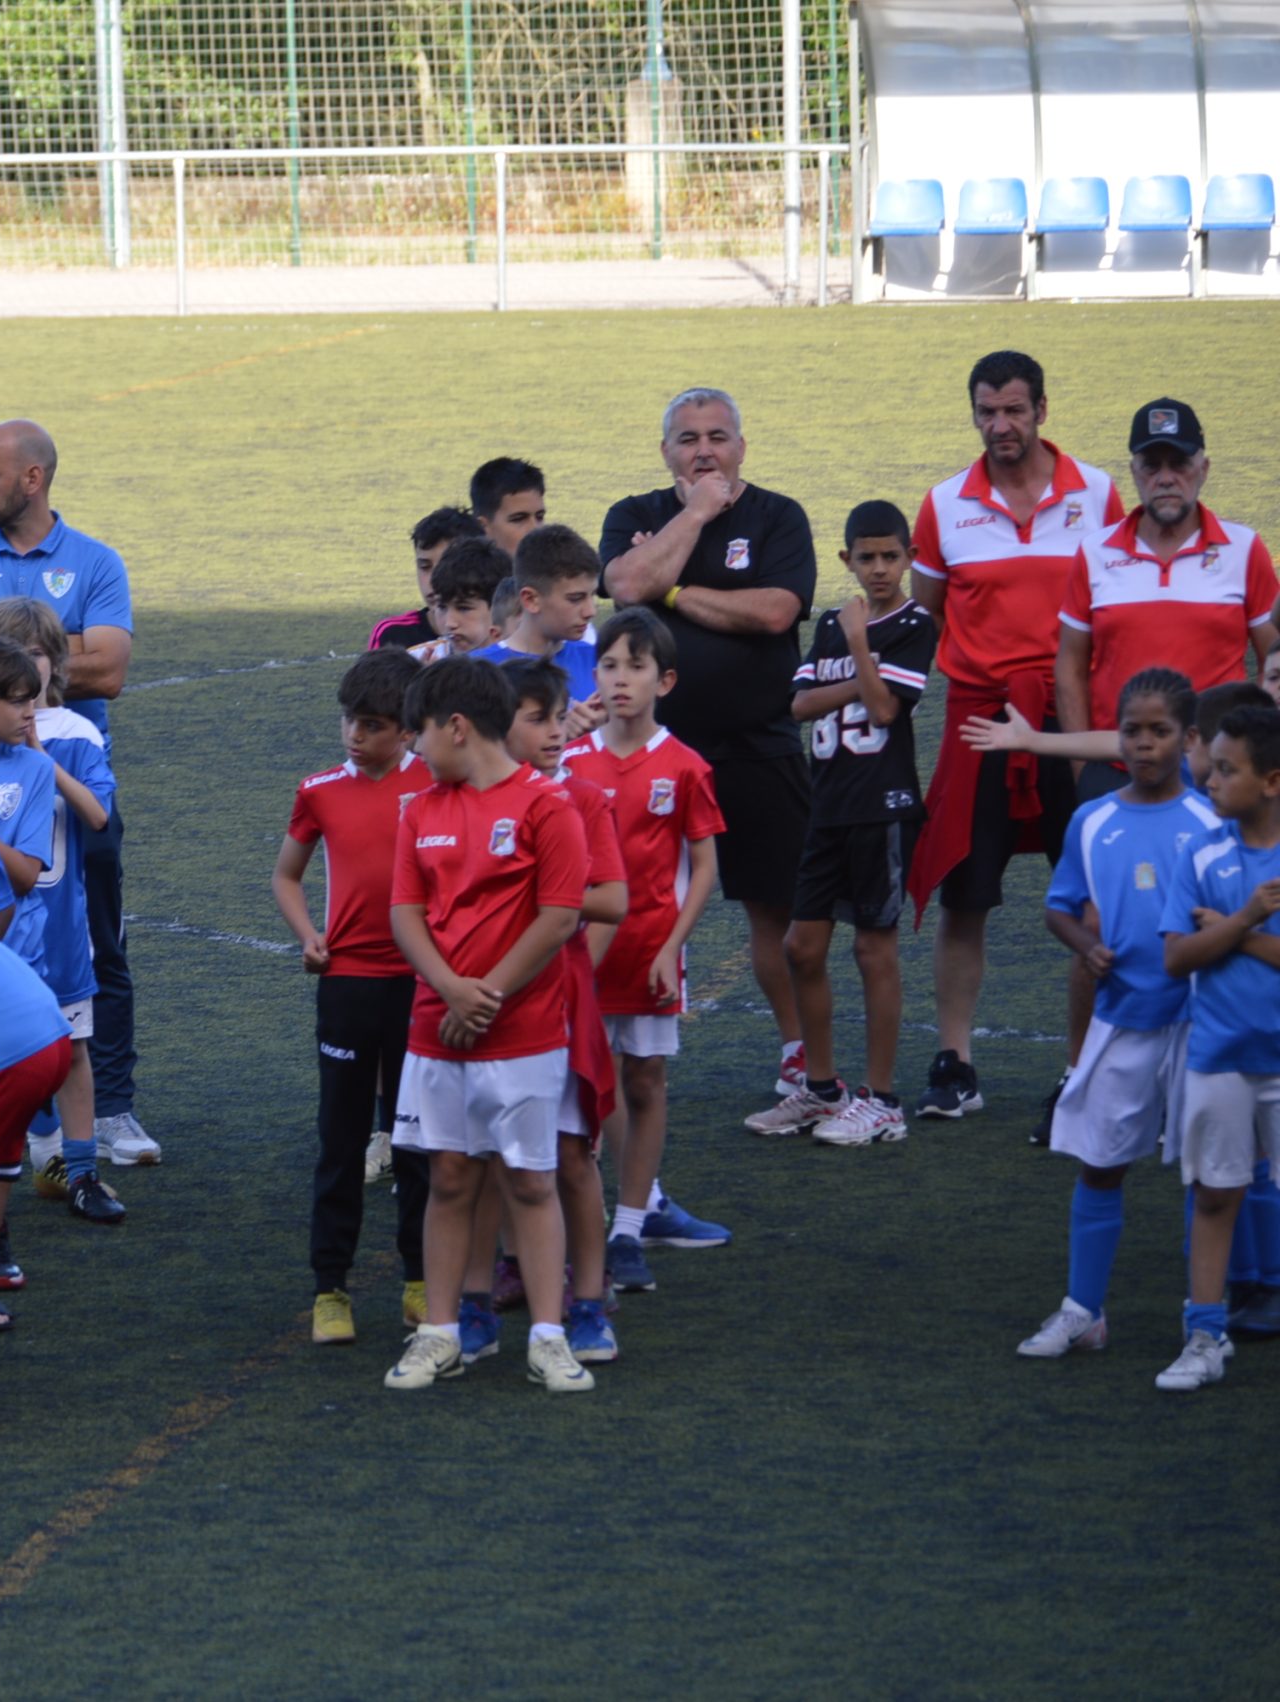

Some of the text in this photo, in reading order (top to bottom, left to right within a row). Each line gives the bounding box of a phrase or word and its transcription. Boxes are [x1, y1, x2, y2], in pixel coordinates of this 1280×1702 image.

[955, 514, 997, 529] LEGEA
[812, 702, 889, 760] 85
[304, 770, 348, 789] LEGEA
[415, 836, 457, 849] LEGEA
